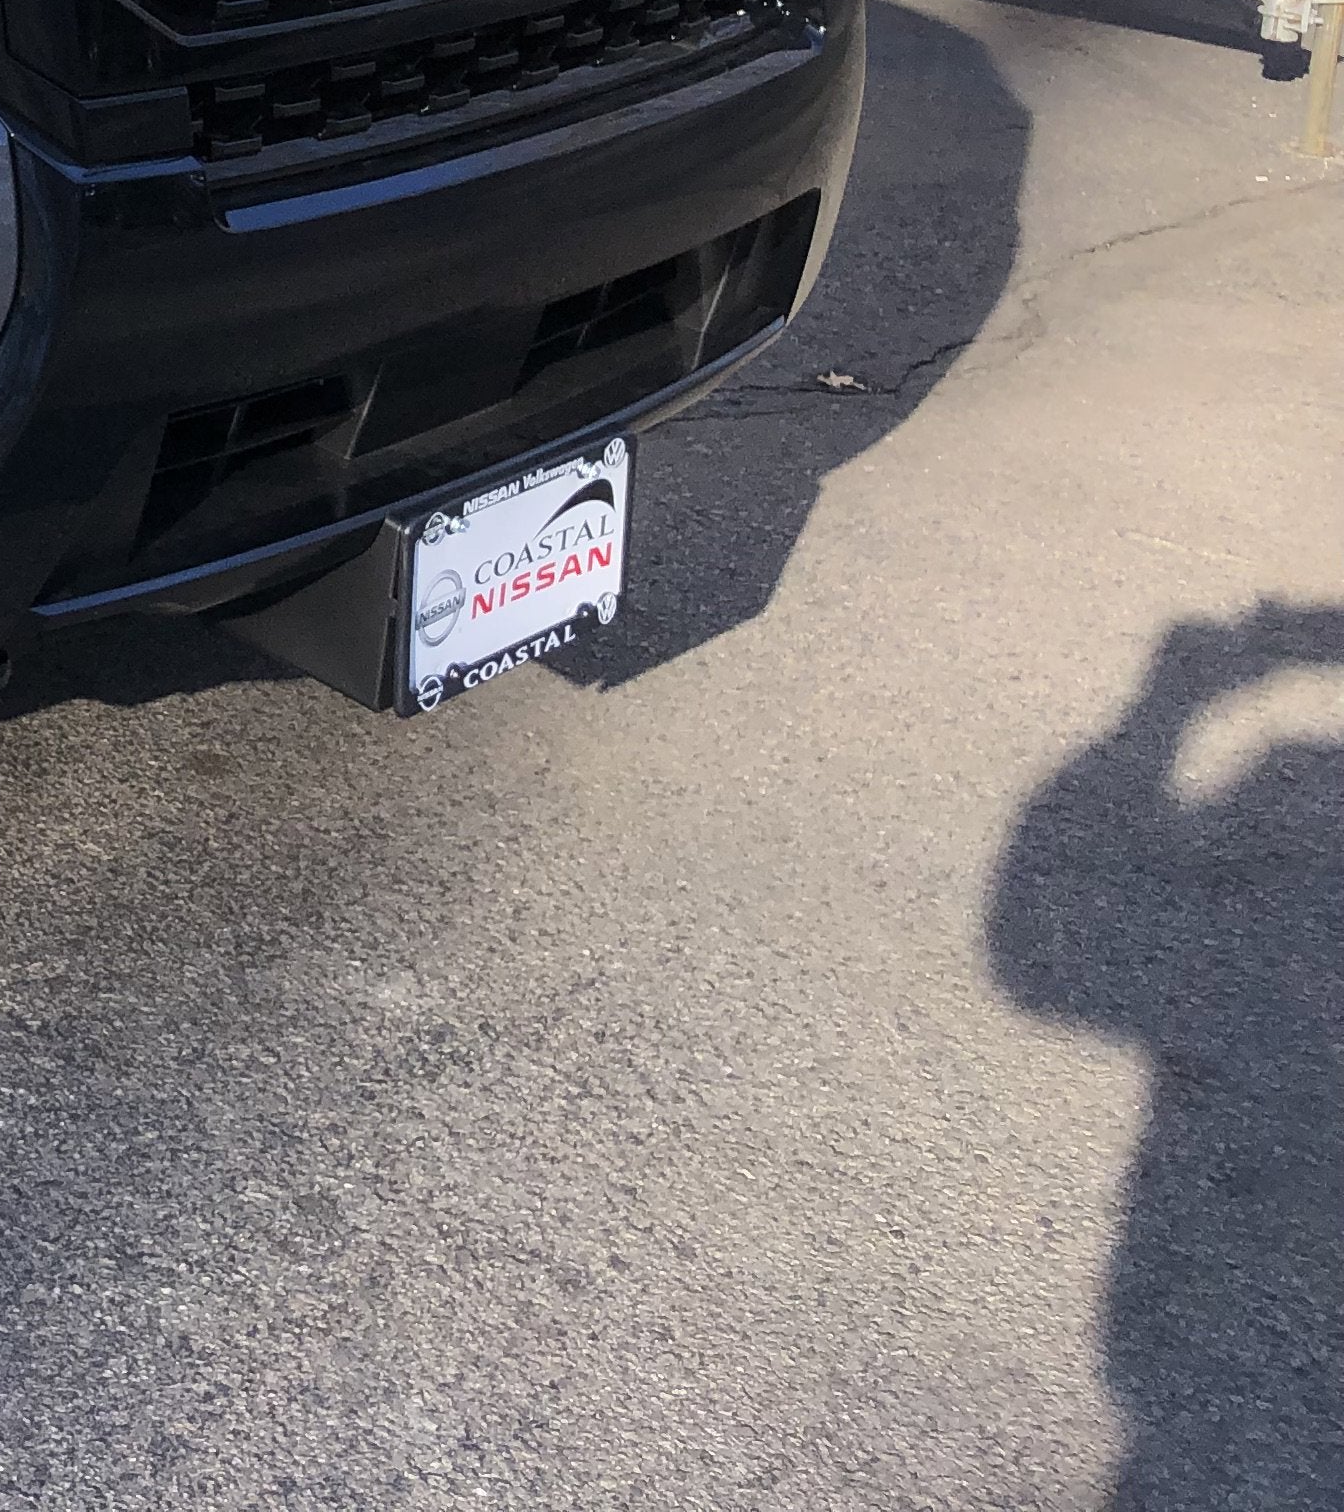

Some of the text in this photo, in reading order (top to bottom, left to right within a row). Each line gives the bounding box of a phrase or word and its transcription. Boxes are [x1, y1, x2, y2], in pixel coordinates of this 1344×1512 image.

[462, 480, 520, 515] NISSAN
[471, 542, 613, 620] NISSAN
[474, 514, 615, 585] COASTAL
[421, 593, 461, 622] NISSAN
[463, 624, 576, 689] COASTAL
